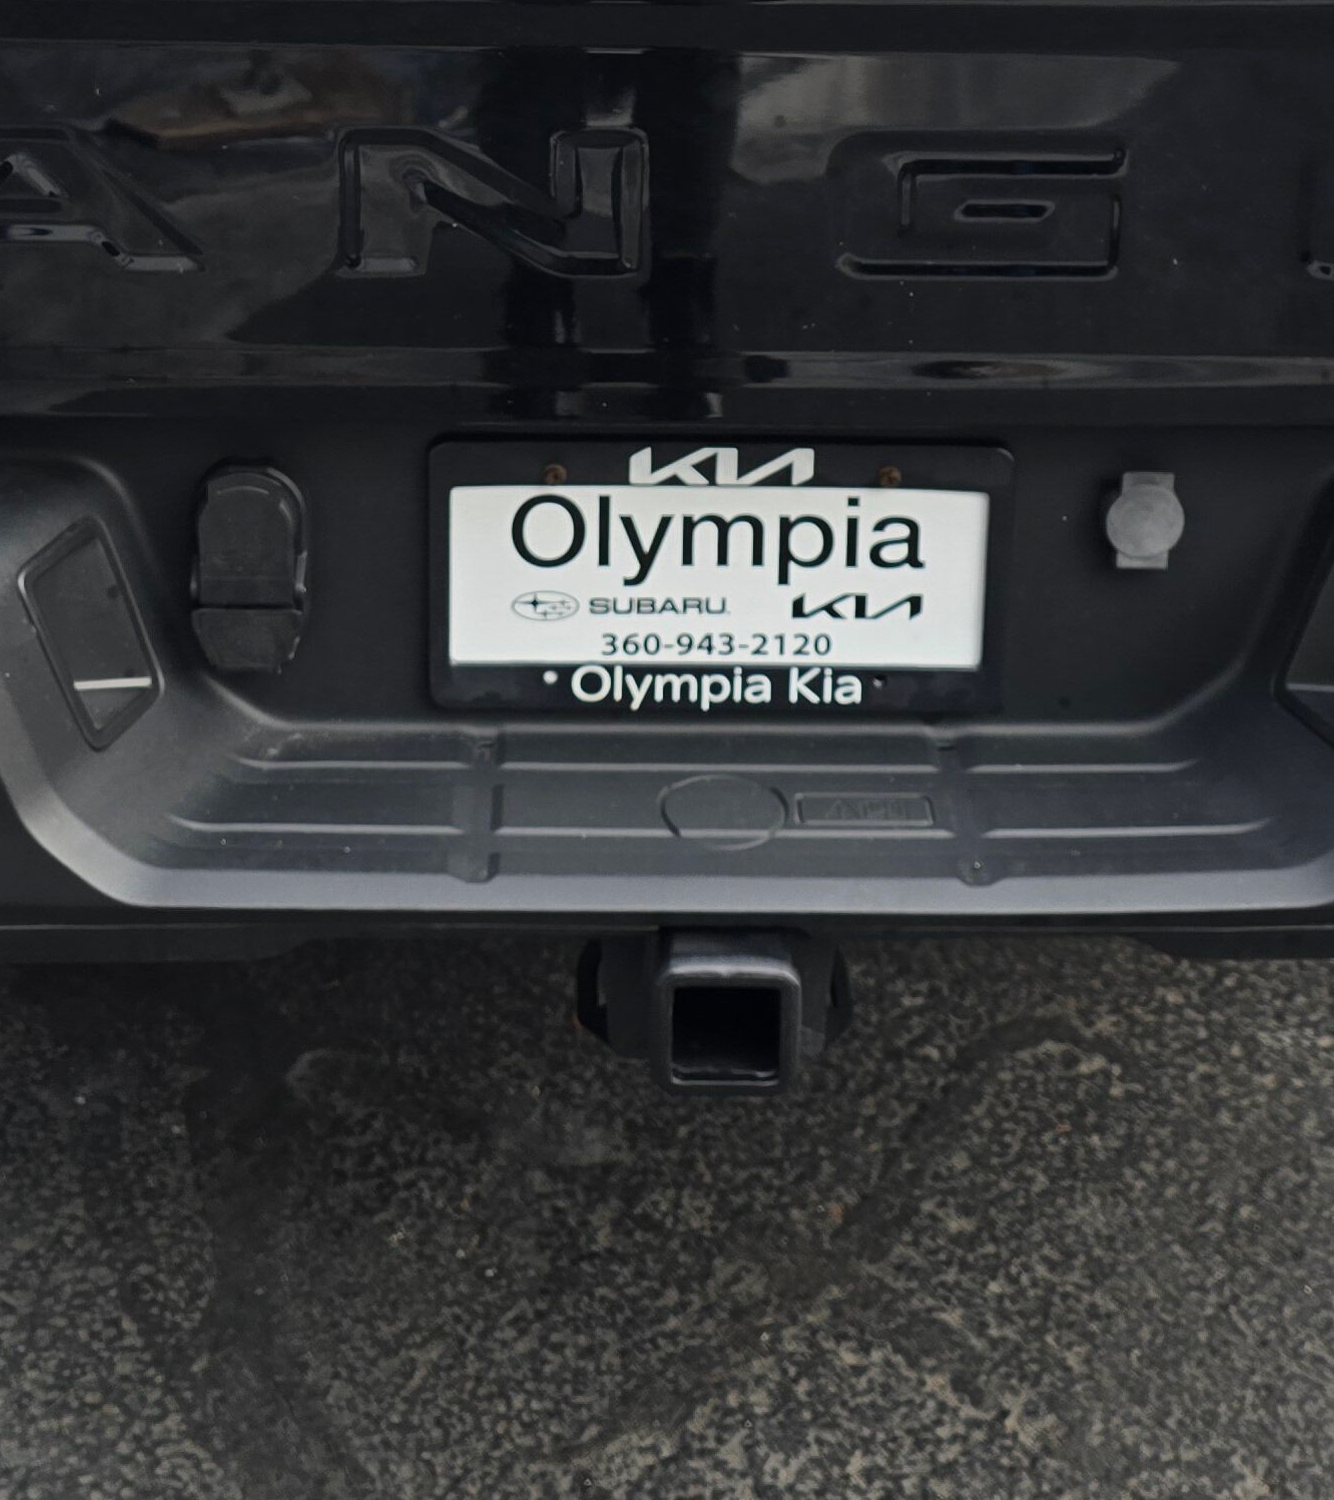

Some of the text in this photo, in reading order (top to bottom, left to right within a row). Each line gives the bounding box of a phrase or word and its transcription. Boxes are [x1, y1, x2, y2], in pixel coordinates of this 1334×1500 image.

[510, 493, 926, 587] Olympia
[588, 596, 729, 616] SUBARU
[601, 632, 833, 657] 360-943-2120
[571, 664, 863, 712] Olympia Kia
